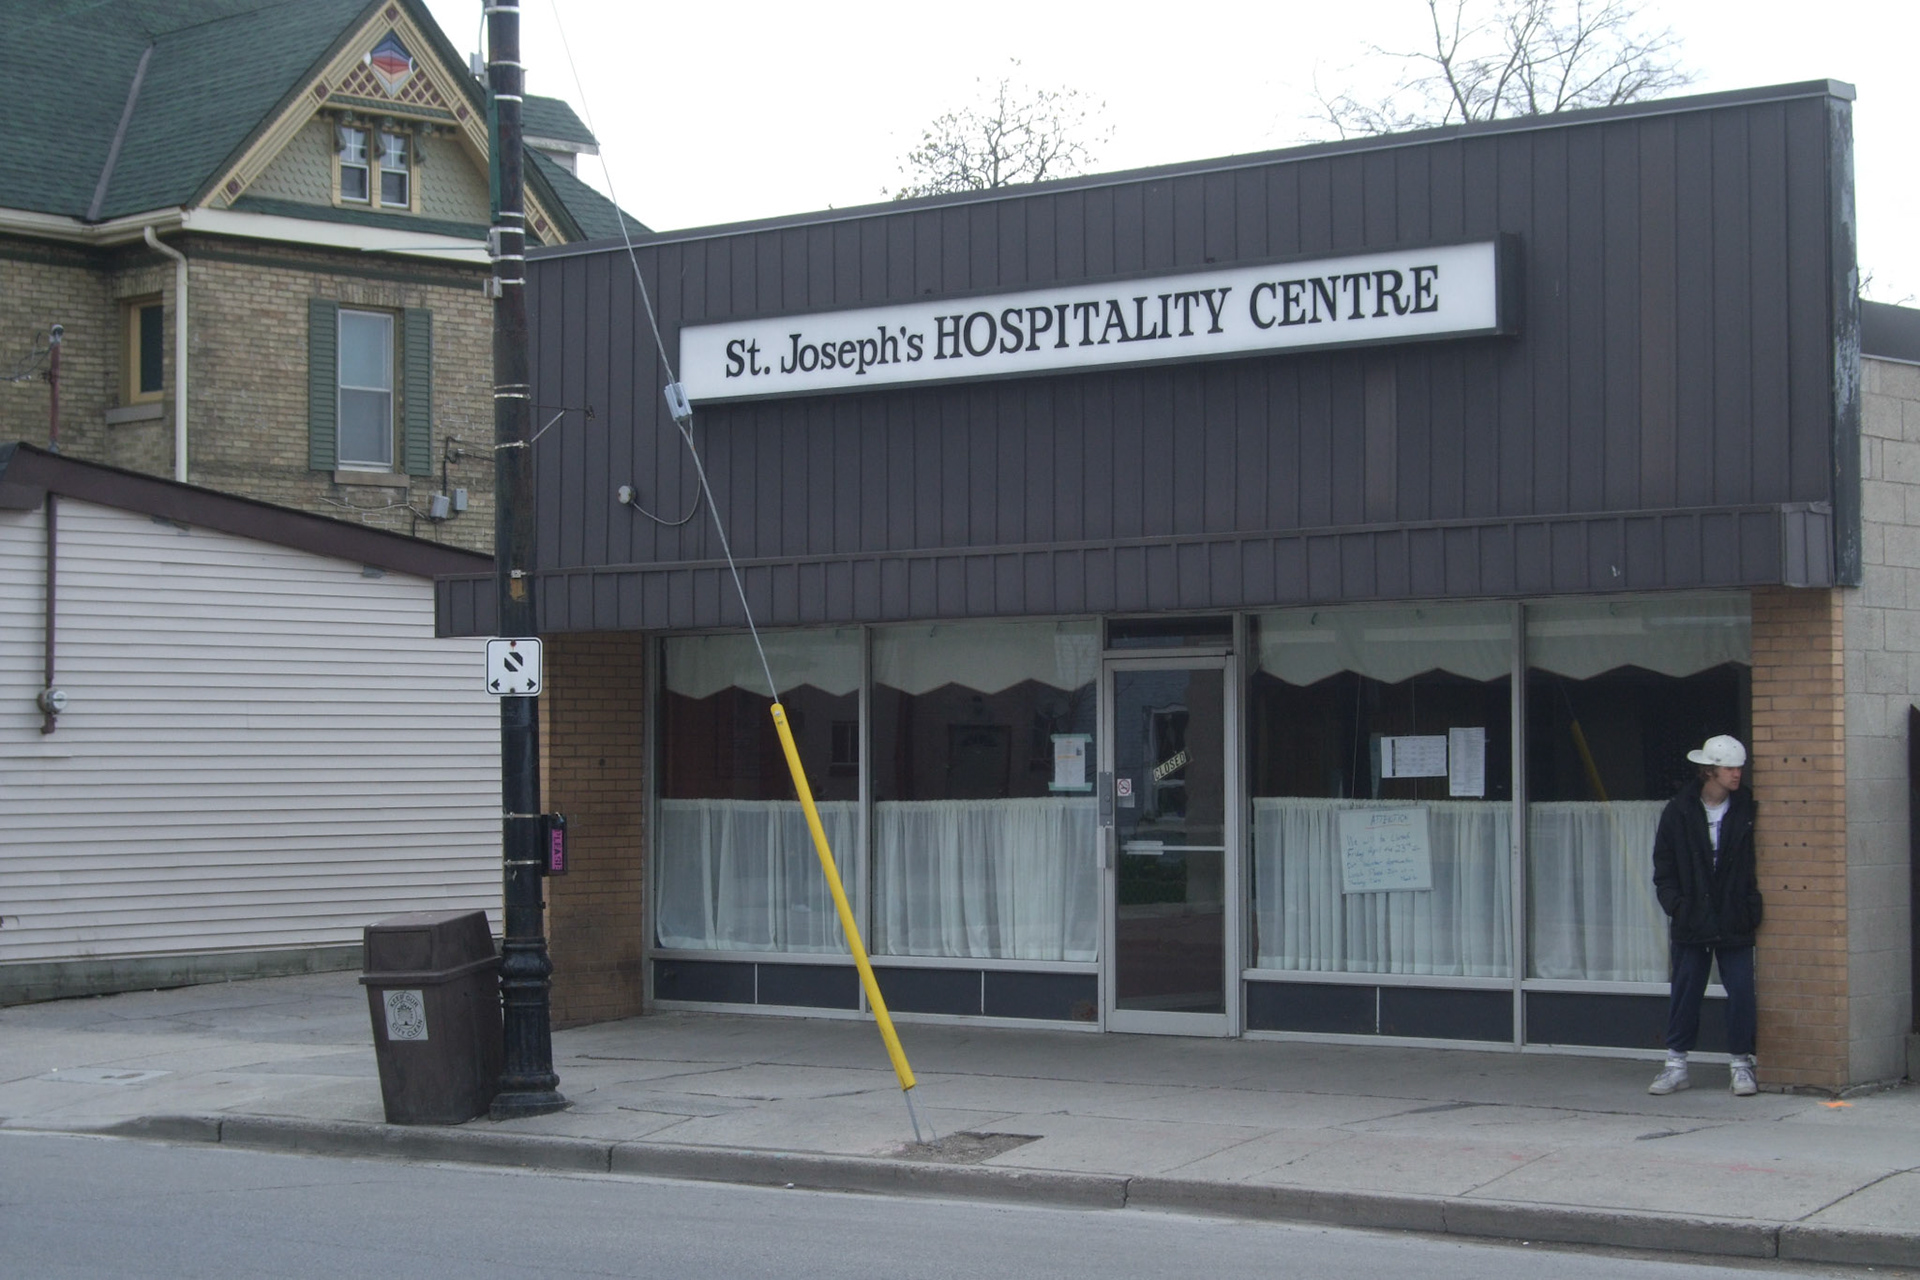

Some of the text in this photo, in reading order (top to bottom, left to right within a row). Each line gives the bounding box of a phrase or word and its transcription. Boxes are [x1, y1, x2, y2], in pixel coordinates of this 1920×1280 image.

[726, 265, 1439, 378] St. Joseph's HOSPITALITY CENTRE
[1154, 752, 1185, 779] CLOSED
[553, 829, 562, 870] PLEASE
[390, 994, 419, 1007] KEEP OUR
[392, 1019, 423, 1036] CITY CLEAN
